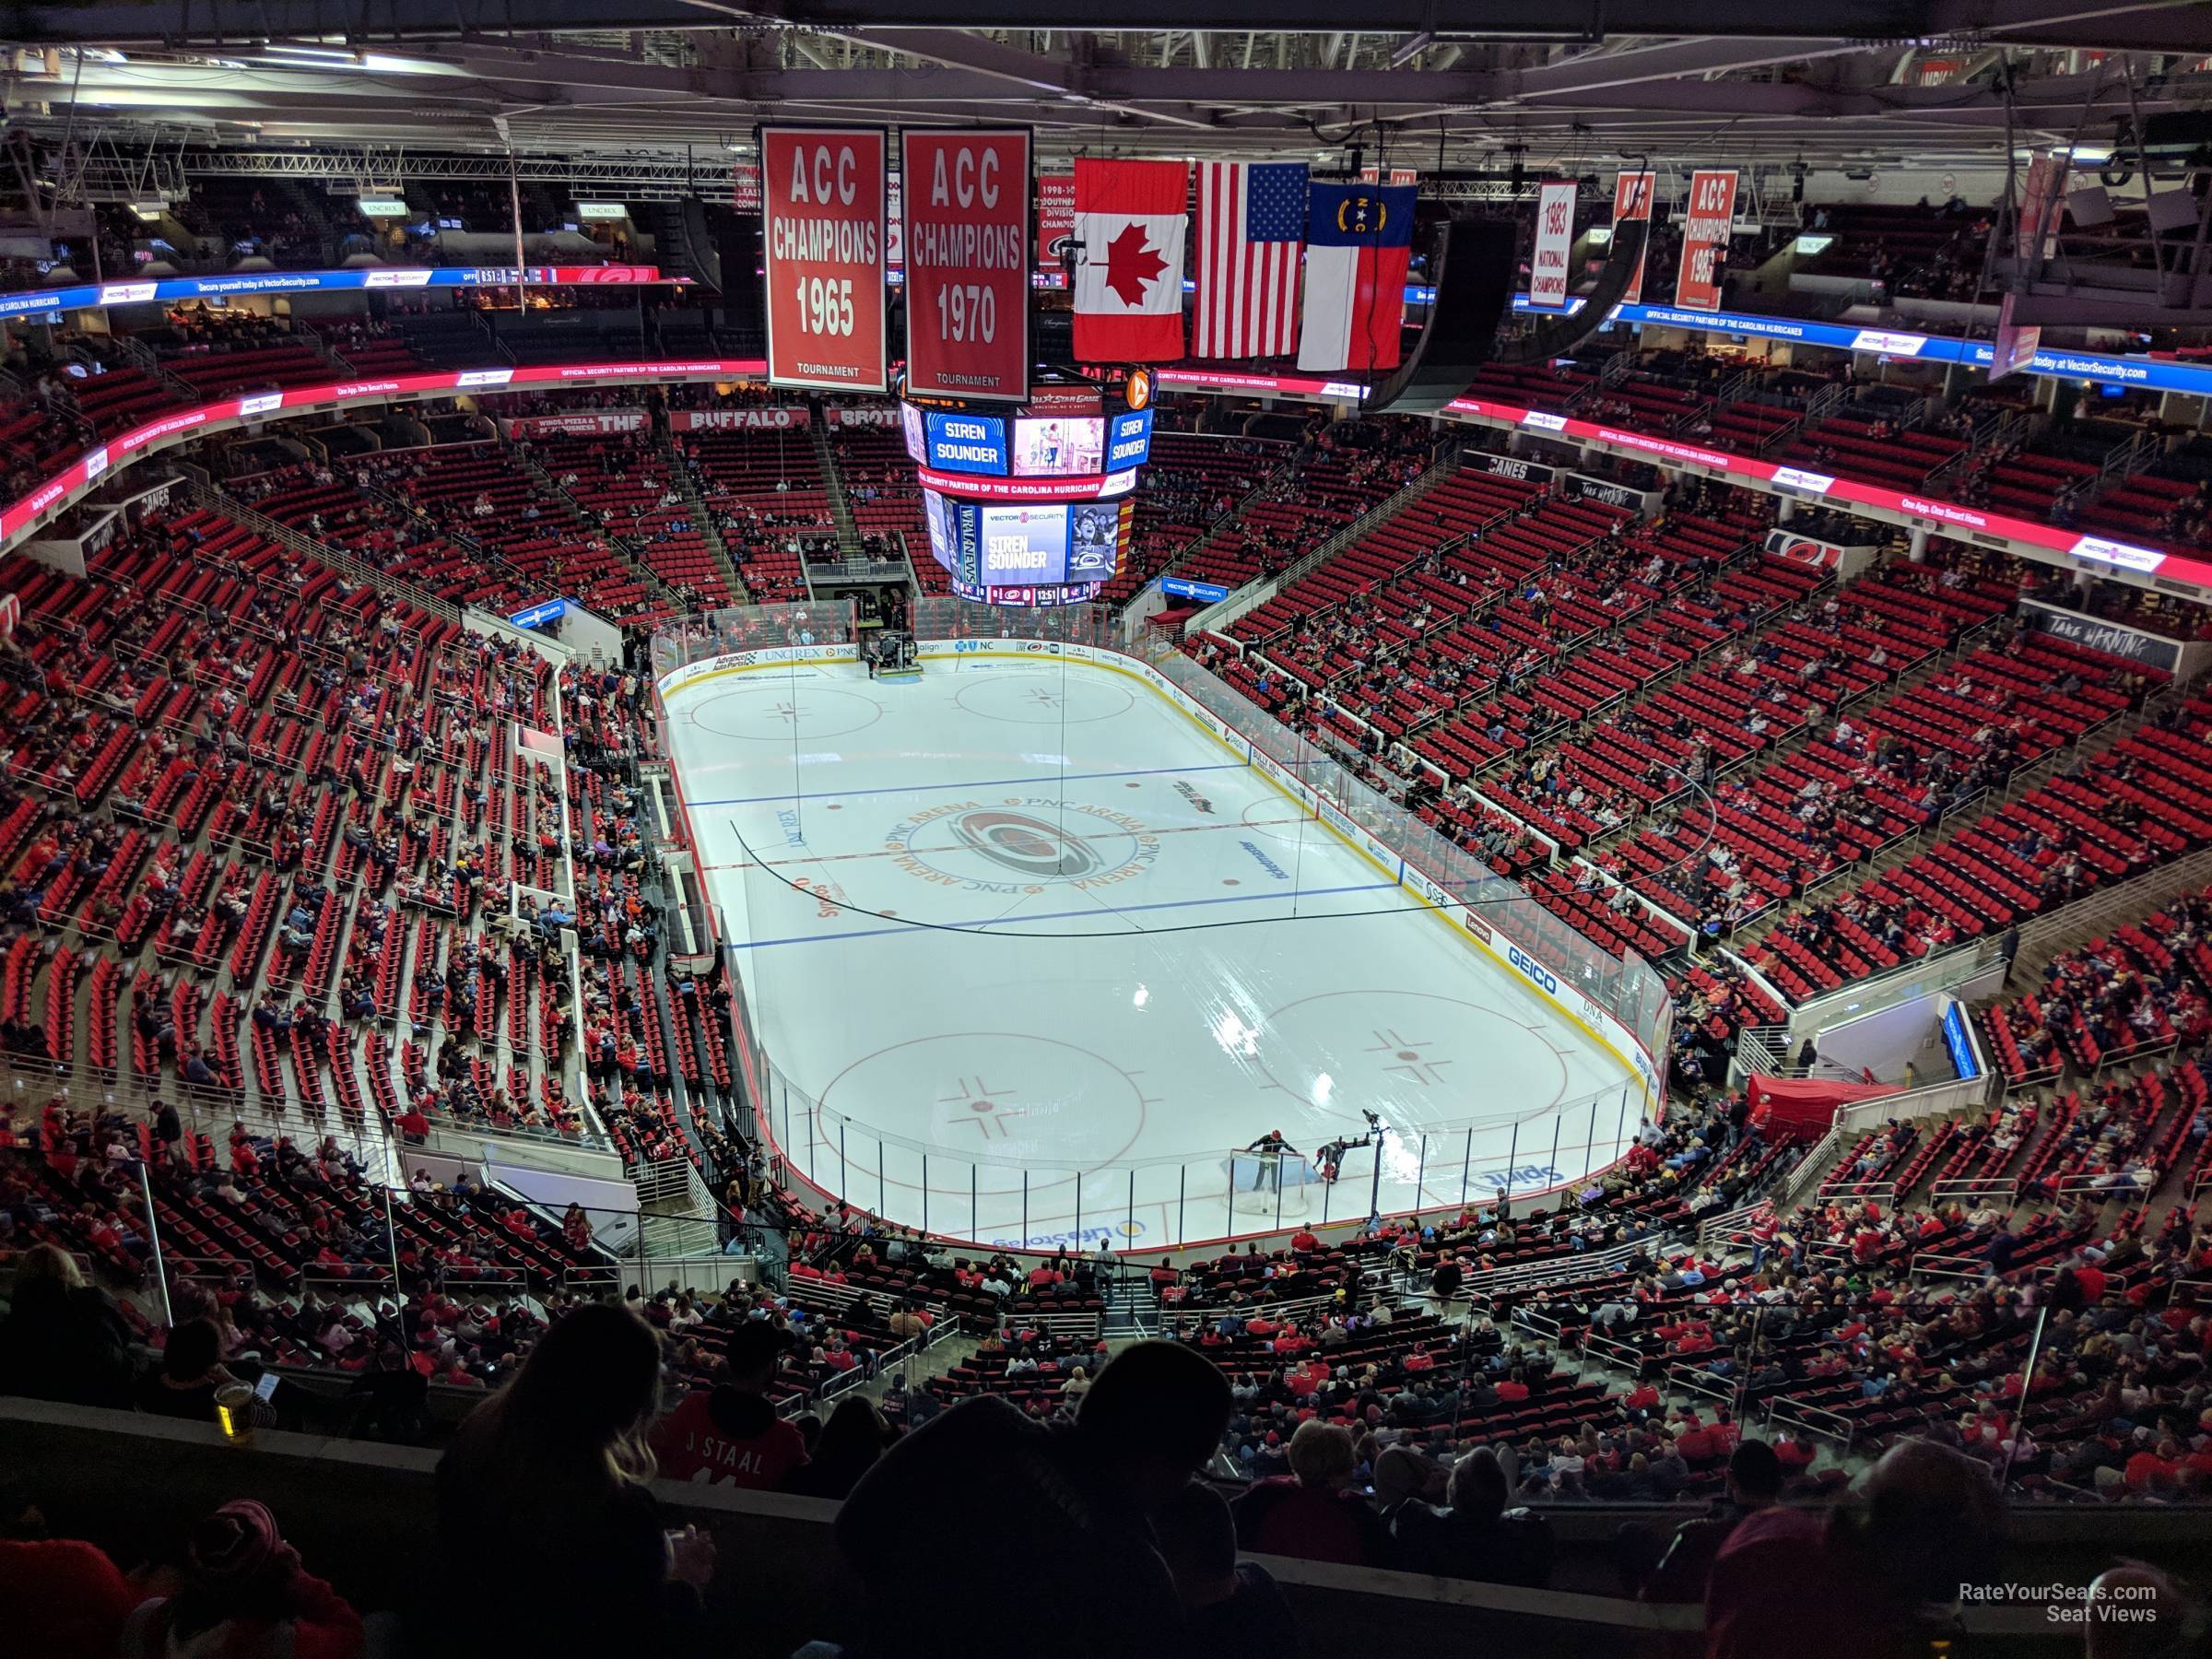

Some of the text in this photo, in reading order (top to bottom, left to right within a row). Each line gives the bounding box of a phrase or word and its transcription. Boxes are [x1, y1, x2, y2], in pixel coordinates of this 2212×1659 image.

[791, 146, 856, 206] ACC
[932, 147, 999, 209] ACC
[1698, 179, 1726, 211] ACC
[1047, 209, 1075, 218] DIVISIO
[1545, 203, 1567, 235] 1983
[1041, 220, 1075, 229] CHAMPIO
[1688, 218, 1728, 243] CHAMPIONS
[774, 216, 877, 265] CHAMPIONS
[913, 221, 1020, 270] CHAMPIONS
[1538, 250, 1564, 269] NATIONAL
[198, 283, 218, 292] Secure
[241, 280, 257, 289] today
[265, 277, 320, 288] VectorSecurity.com
[1534, 276, 1565, 294] CHAMPIONS
[797, 276, 853, 336] 1965
[938, 284, 995, 344] 1970
[797, 362, 859, 377] TOURNAMENT
[2034, 356, 2055, 371] today
[2057, 359, 2065, 369] at
[2067, 359, 2147, 378] VectorSecurity.com
[936, 373, 1000, 388] TOURNAMENT
[598, 415, 643, 431] THE
[691, 411, 790, 429] BUFFALO
[841, 410, 902, 426] BROT
[1121, 418, 1143, 437] SIREN
[945, 422, 986, 441] SIREN
[937, 443, 998, 464] SOUNDER
[1112, 439, 1146, 460] SOUNDER
[1488, 458, 1528, 479] CANES
[948, 480, 980, 492] PARTNER
[982, 484, 992, 493] OF
[994, 485, 1009, 494] THE
[1011, 485, 1053, 495] CAROLINA
[1054, 483, 1100, 494] HURRICANES
[1030, 512, 1065, 521] SECURITY
[988, 535, 1029, 554] SIREN
[964, 545, 976, 583] NEWS
[988, 551, 1047, 571] SOUNDER
[1038, 590, 1055, 600] 13:51
[765, 648, 821, 660] UNC REX
[980, 641, 994, 650] NC
[712, 663, 726, 672] Auto
[715, 655, 746, 665] Advance
[886, 801, 982, 841] PNC ARENA
[1027, 798, 1146, 831] PNC ARENA
[892, 855, 963, 886] ARENA
[1069, 843, 1159, 890] PNC ARENA
[1467, 912, 1490, 940] Lenovo
[1509, 947, 1557, 994] GEICO
[1583, 1000, 1603, 1023] DNA
[702, 1436, 762, 1475] STAAL
